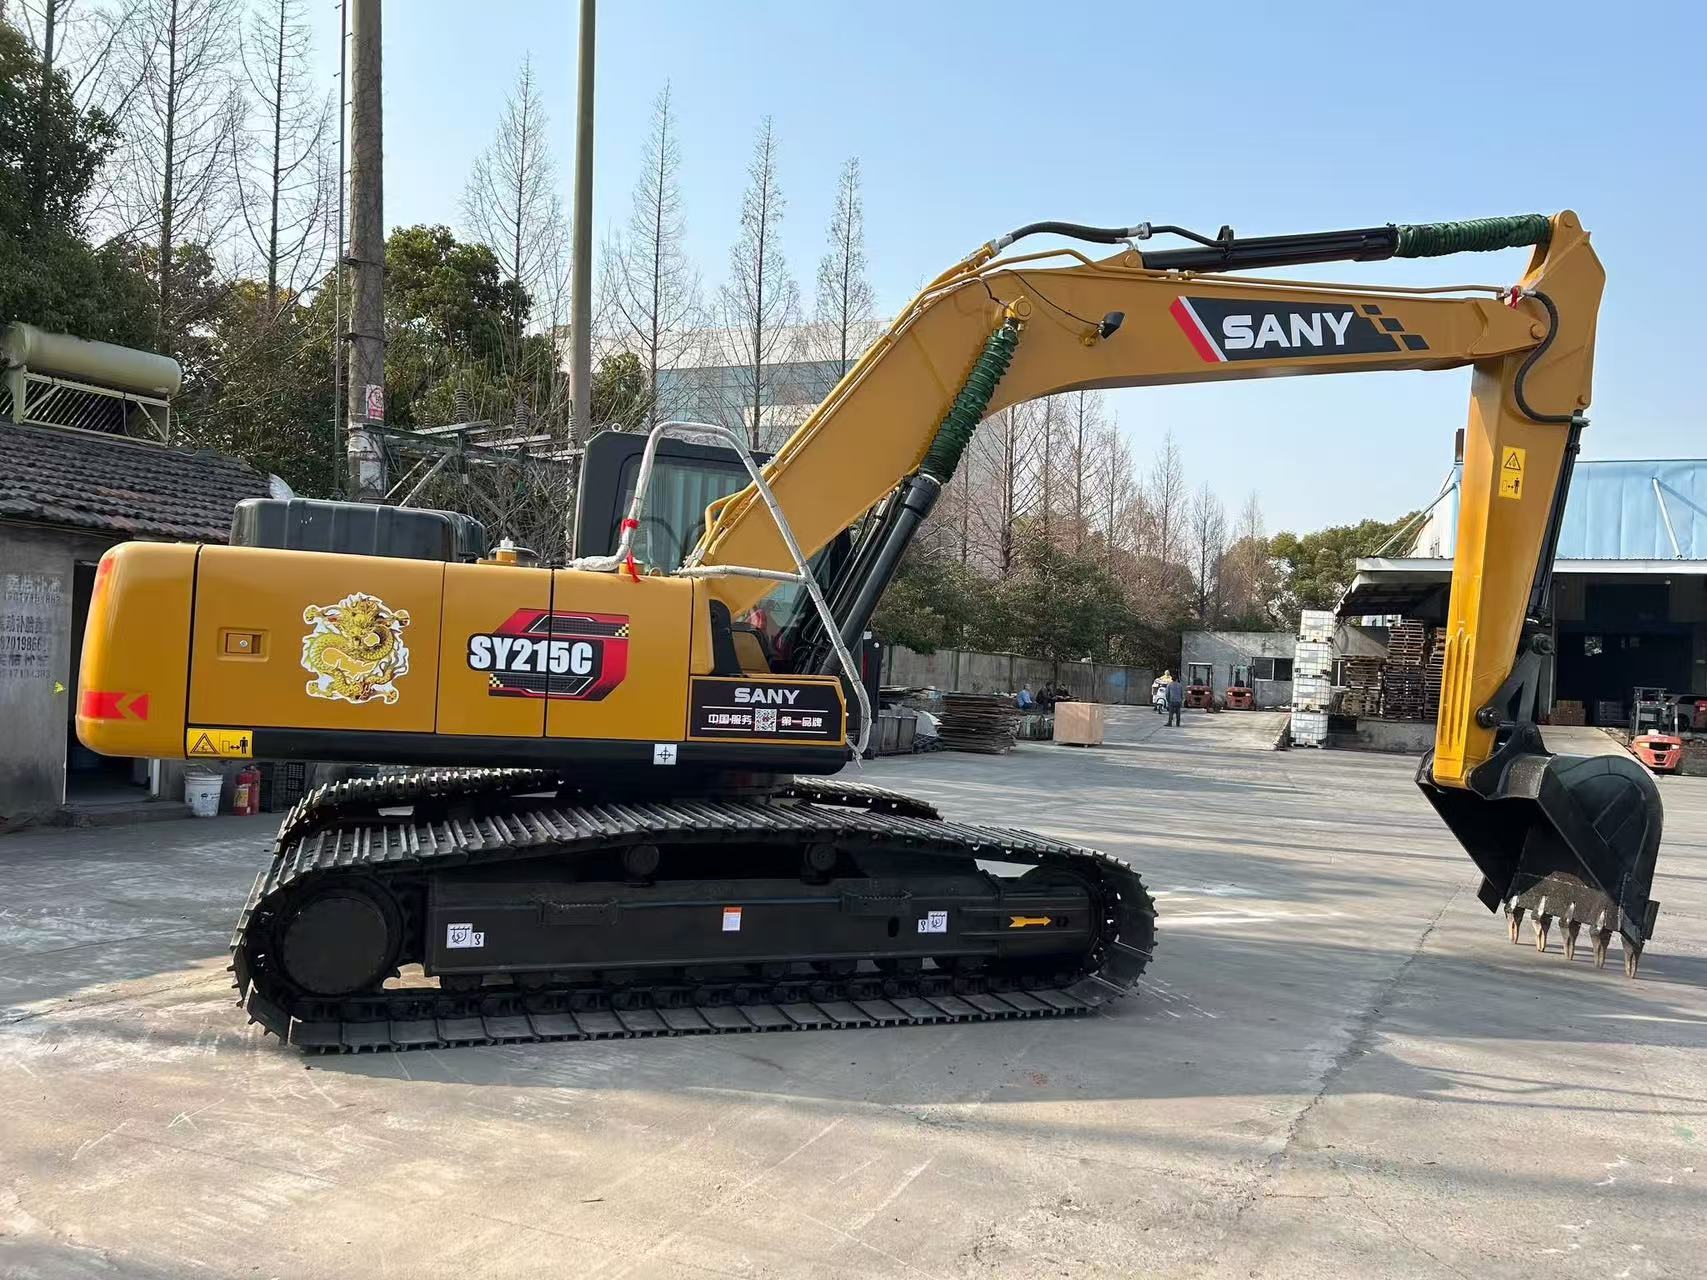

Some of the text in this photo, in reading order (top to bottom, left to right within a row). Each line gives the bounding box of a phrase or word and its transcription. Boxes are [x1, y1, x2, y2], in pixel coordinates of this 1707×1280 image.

[1222, 311, 1354, 349] SANY
[469, 635, 593, 675] SY215C
[734, 687, 800, 705] SANY
[781, 716, 823, 728] 第一品牌
